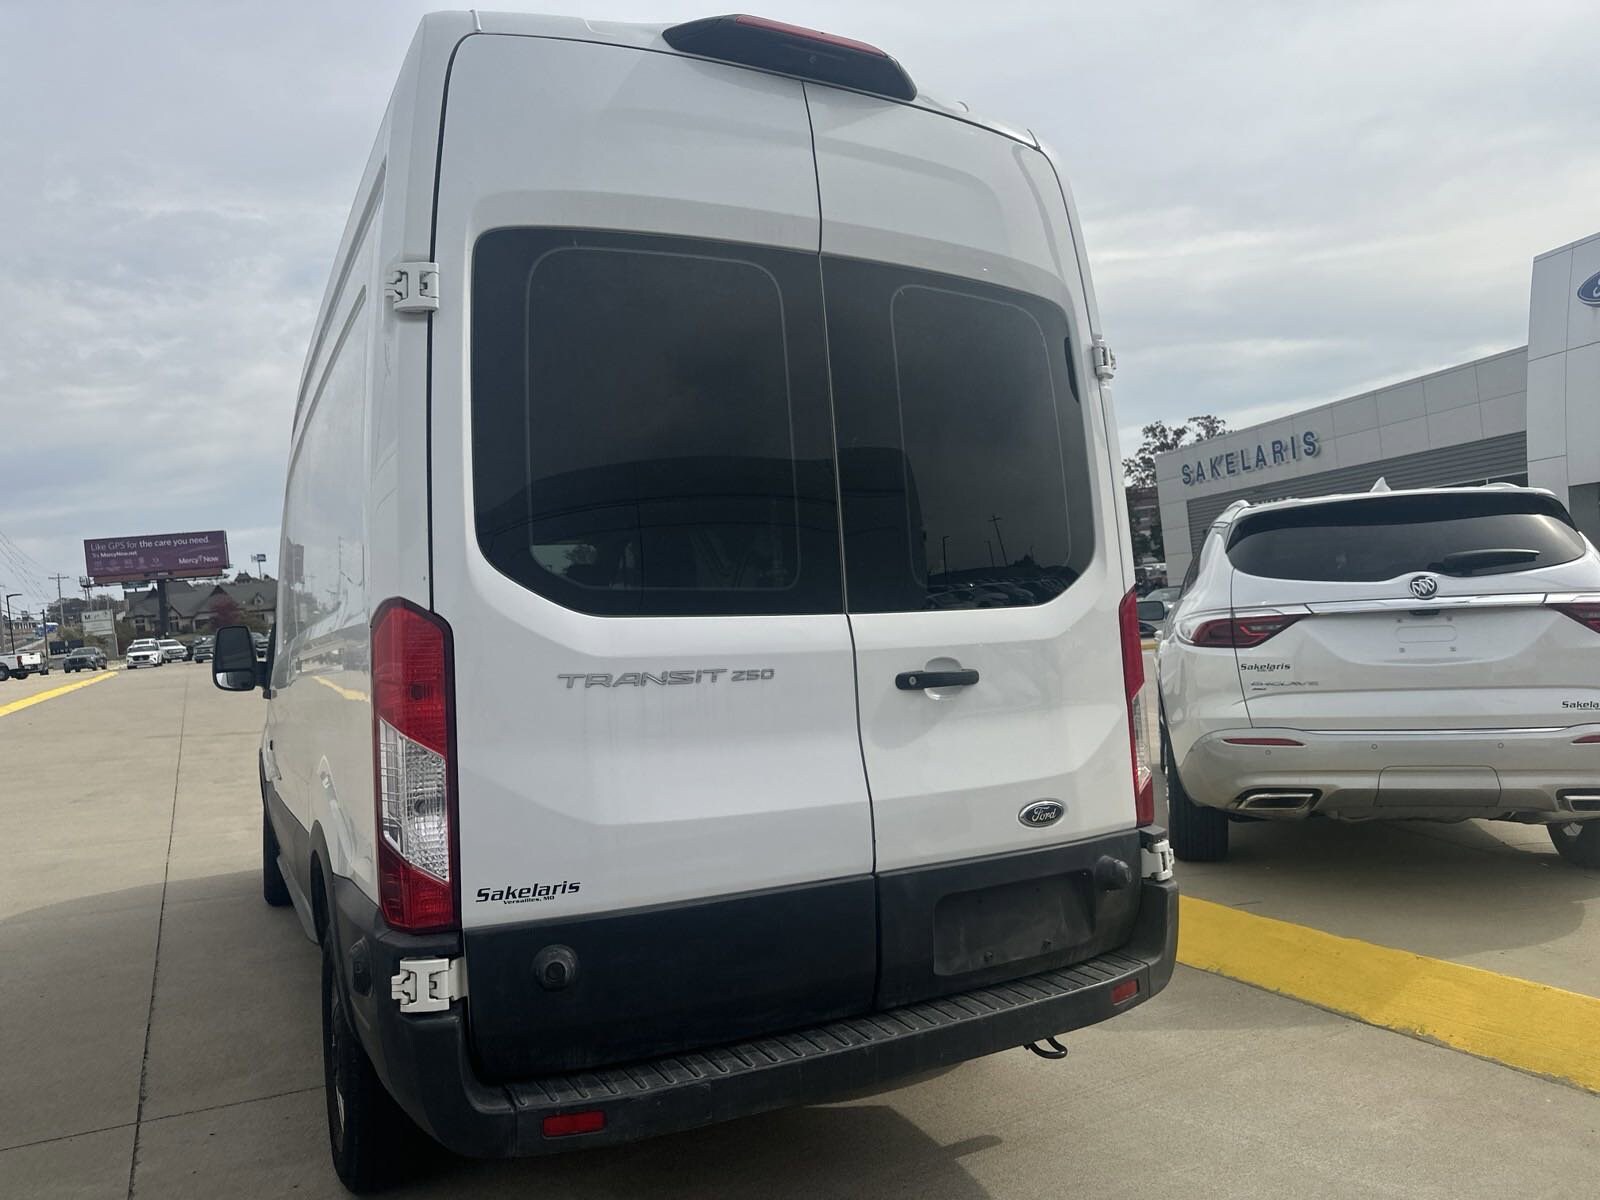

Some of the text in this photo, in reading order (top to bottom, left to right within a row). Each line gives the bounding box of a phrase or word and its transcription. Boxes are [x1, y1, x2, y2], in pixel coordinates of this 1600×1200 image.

[1181, 431, 1318, 485] SAKELARIS
[90, 543, 106, 551] Like
[108, 541, 126, 550] GPS
[127, 540, 137, 549] for
[139, 539, 153, 548] the
[154, 539, 172, 547] care
[173, 538, 188, 547] you
[1240, 663, 1291, 671] Sakelaris
[557, 668, 775, 689] TRANSIT 250
[1031, 806, 1057, 822] Ford
[475, 880, 581, 903] Sakelaris
